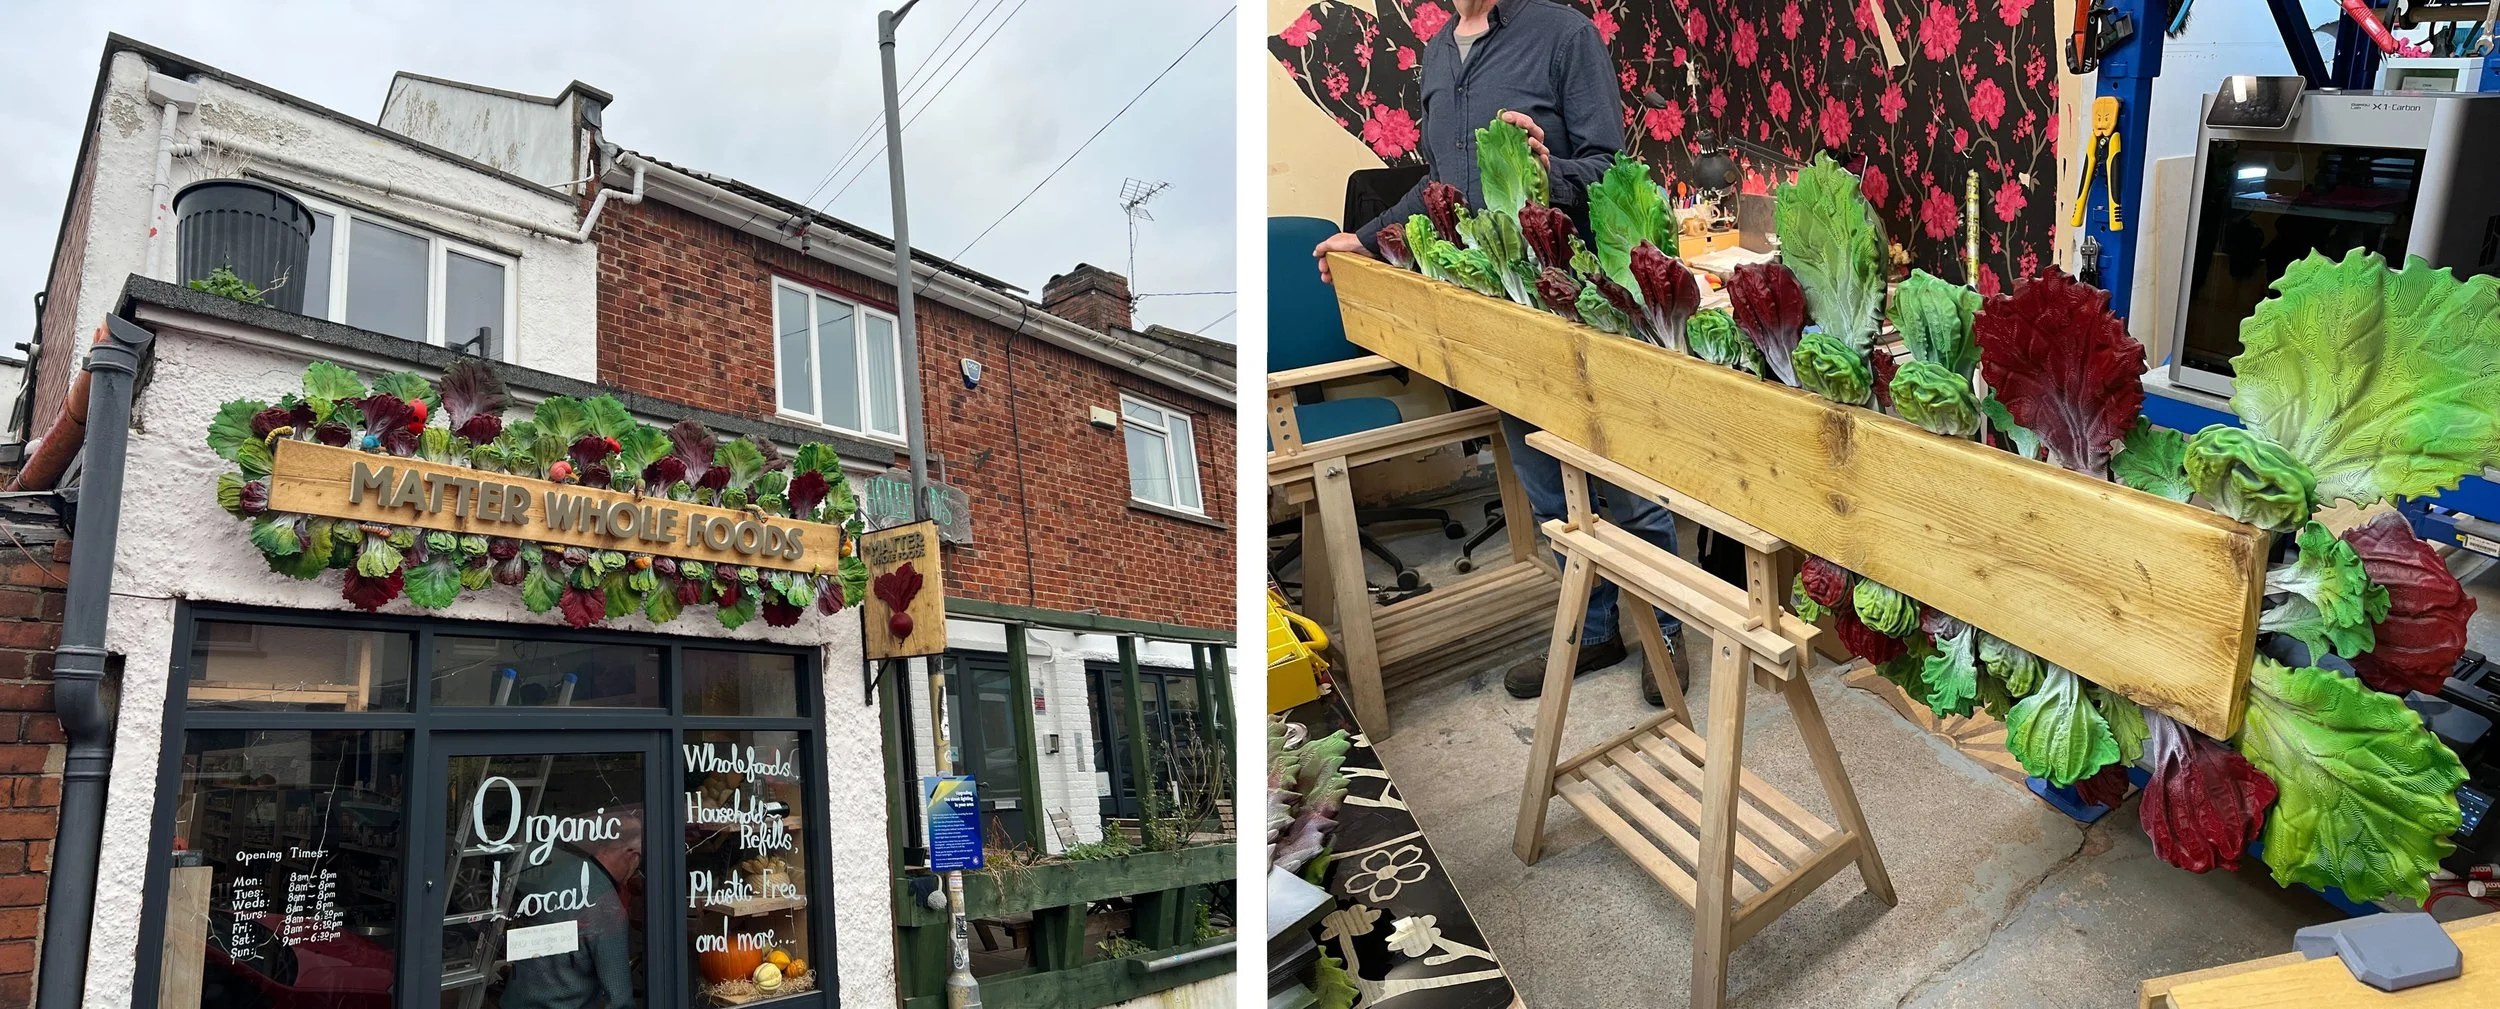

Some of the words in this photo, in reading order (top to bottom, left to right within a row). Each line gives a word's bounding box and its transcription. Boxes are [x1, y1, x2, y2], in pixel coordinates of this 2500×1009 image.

[349, 461, 532, 525] MATTER
[543, 491, 679, 543] WHOLE
[687, 512, 804, 560] FOODS
[869, 532, 925, 557] MATTER
[898, 549, 925, 561] FOODS
[473, 776, 622, 865] Organic
[236, 850, 282, 866] Opening
[290, 847, 328, 858] Times:
[233, 876, 262, 887] Mon:
[290, 872, 309, 881] 8am
[320, 869, 337, 881] 8pm
[234, 889, 264, 900] Tues:
[288, 882, 308, 892] 8am
[318, 880, 335, 891] 8pm
[232, 897, 270, 910] Weds:
[287, 893, 305, 902] 8am
[317, 891, 336, 902] 8pm
[490, 861, 596, 922] Local
[232, 923, 252, 934] Fri:
[285, 915, 304, 924] 8am
[314, 910, 344, 921] 6:30pm
[233, 910, 267, 922] Thurs:
[286, 904, 303, 914] 8am
[316, 900, 334, 911] 8pm
[230, 948, 254, 959] Sun:
[282, 937, 301, 947] 9am
[310, 931, 341, 942] 6:30pm
[232, 933, 255, 946] Sat:
[283, 925, 303, 935] 8am
[313, 920, 343, 931] 6:30pm
[696, 915, 729, 953] and
